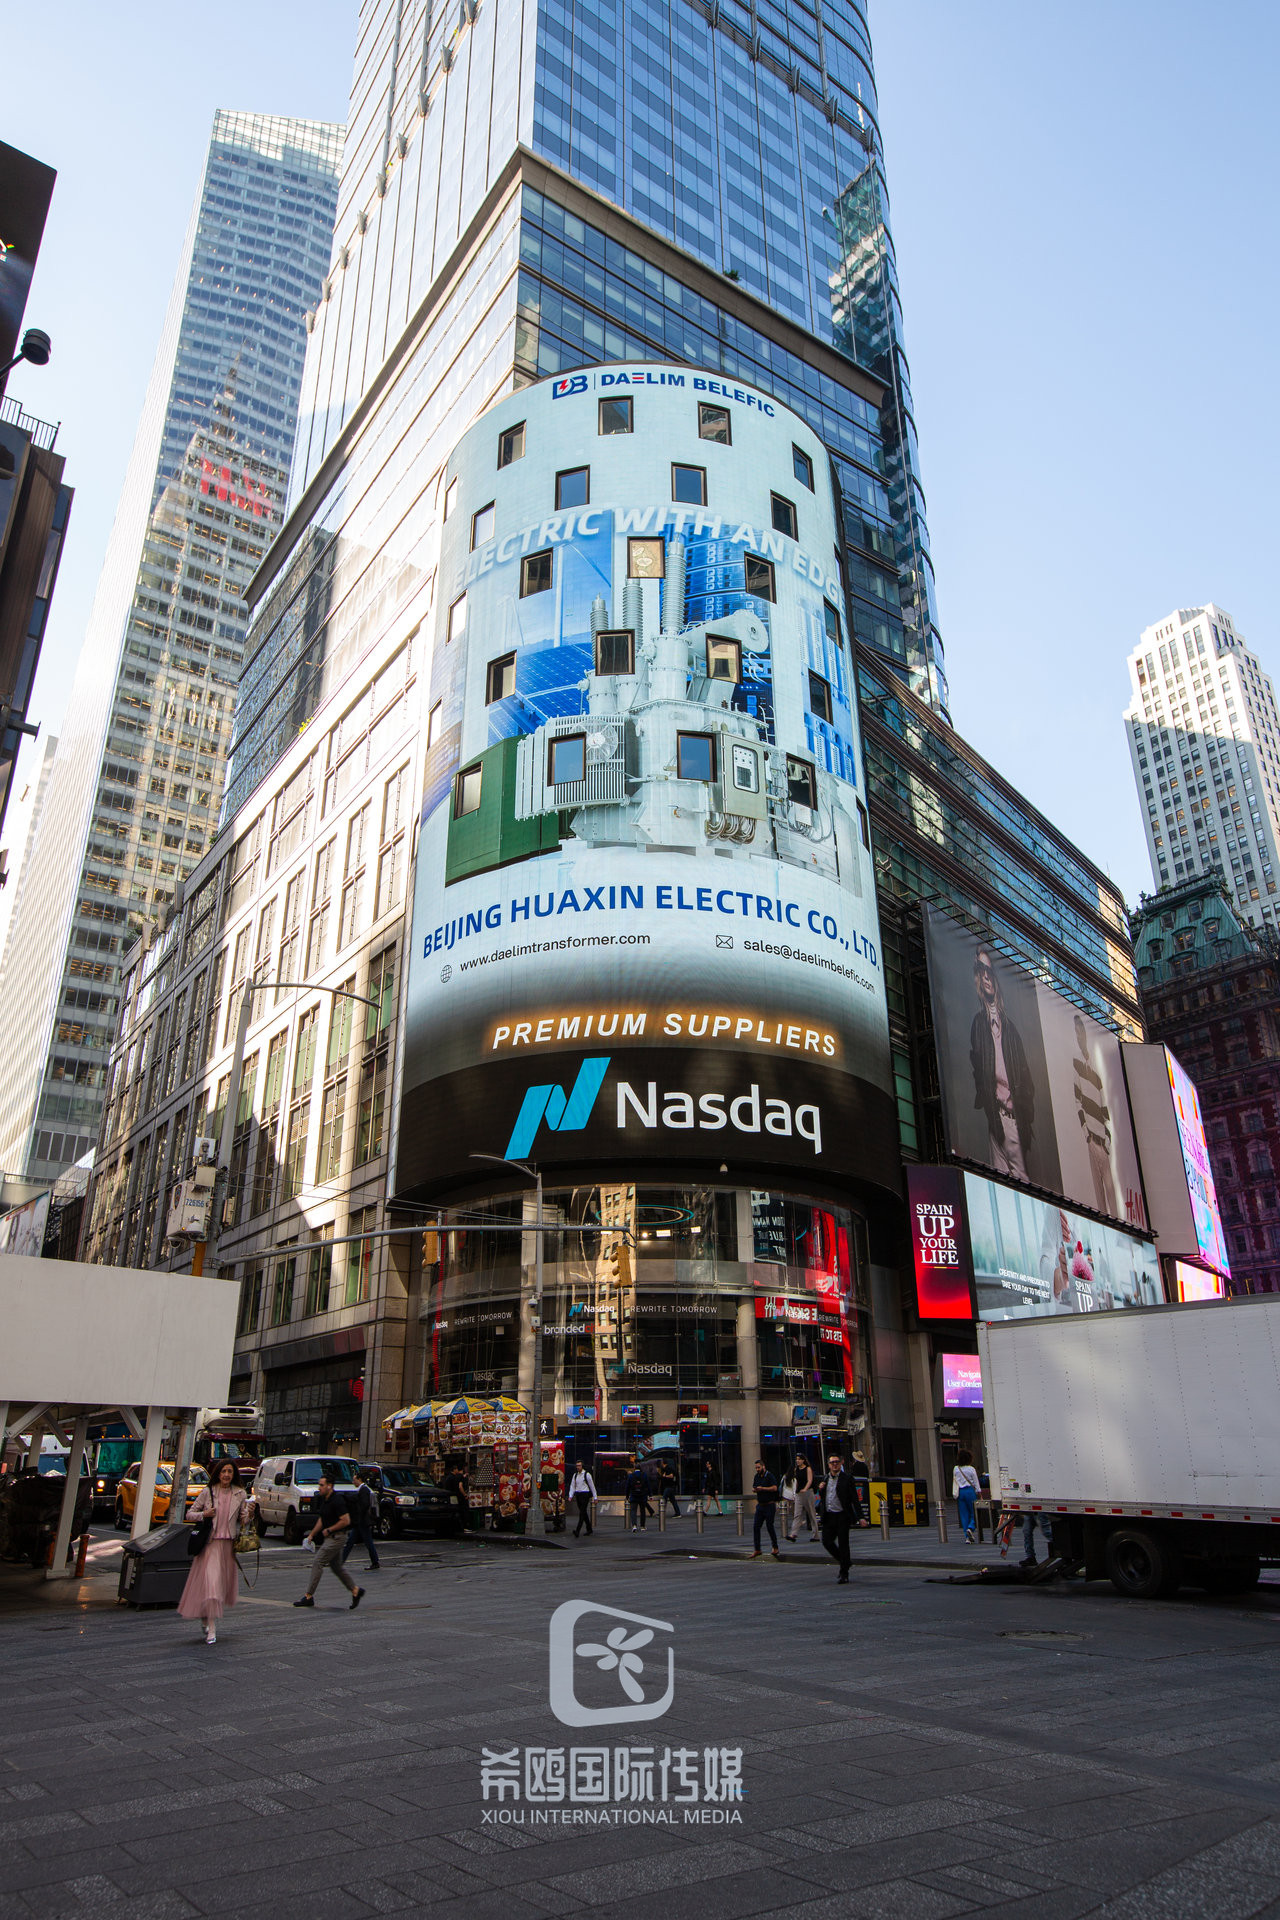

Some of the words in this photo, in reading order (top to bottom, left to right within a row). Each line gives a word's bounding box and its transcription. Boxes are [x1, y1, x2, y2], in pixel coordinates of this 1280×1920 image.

[601, 372, 685, 387] DAELIM
[693, 377, 775, 418] BELEFIC
[452, 509, 606, 592] ELECTRIC
[613, 506, 722, 539] WITH
[730, 522, 785, 562] AN
[423, 903, 502, 959] BEIJING
[510, 885, 644, 923] HUAXIN
[656, 885, 801, 928] ELECTRIC
[460, 934, 651, 972] www.daelimtransformer.com
[744, 939, 876, 995] sales@daelimbelefic.com
[493, 1013, 647, 1050] PREMIUM
[663, 1013, 836, 1056] SUPPLIERS
[617, 1081, 822, 1155] Nasdaq
[916, 1203, 953, 1216] SPAIN
[917, 1215, 955, 1238] UP
[919, 1237, 957, 1250] YOUR
[920, 1249, 959, 1265] LIFE
[1075, 1280, 1092, 1294] SPAIN
[584, 1304, 615, 1314] Nasdaq
[630, 1305, 667, 1313] REWRITE
[671, 1305, 718, 1314] TOMORROW
[1076, 1292, 1094, 1313] UP
[477, 1311, 513, 1322] TOMORROW
[628, 1362, 673, 1376] Nasdaq
